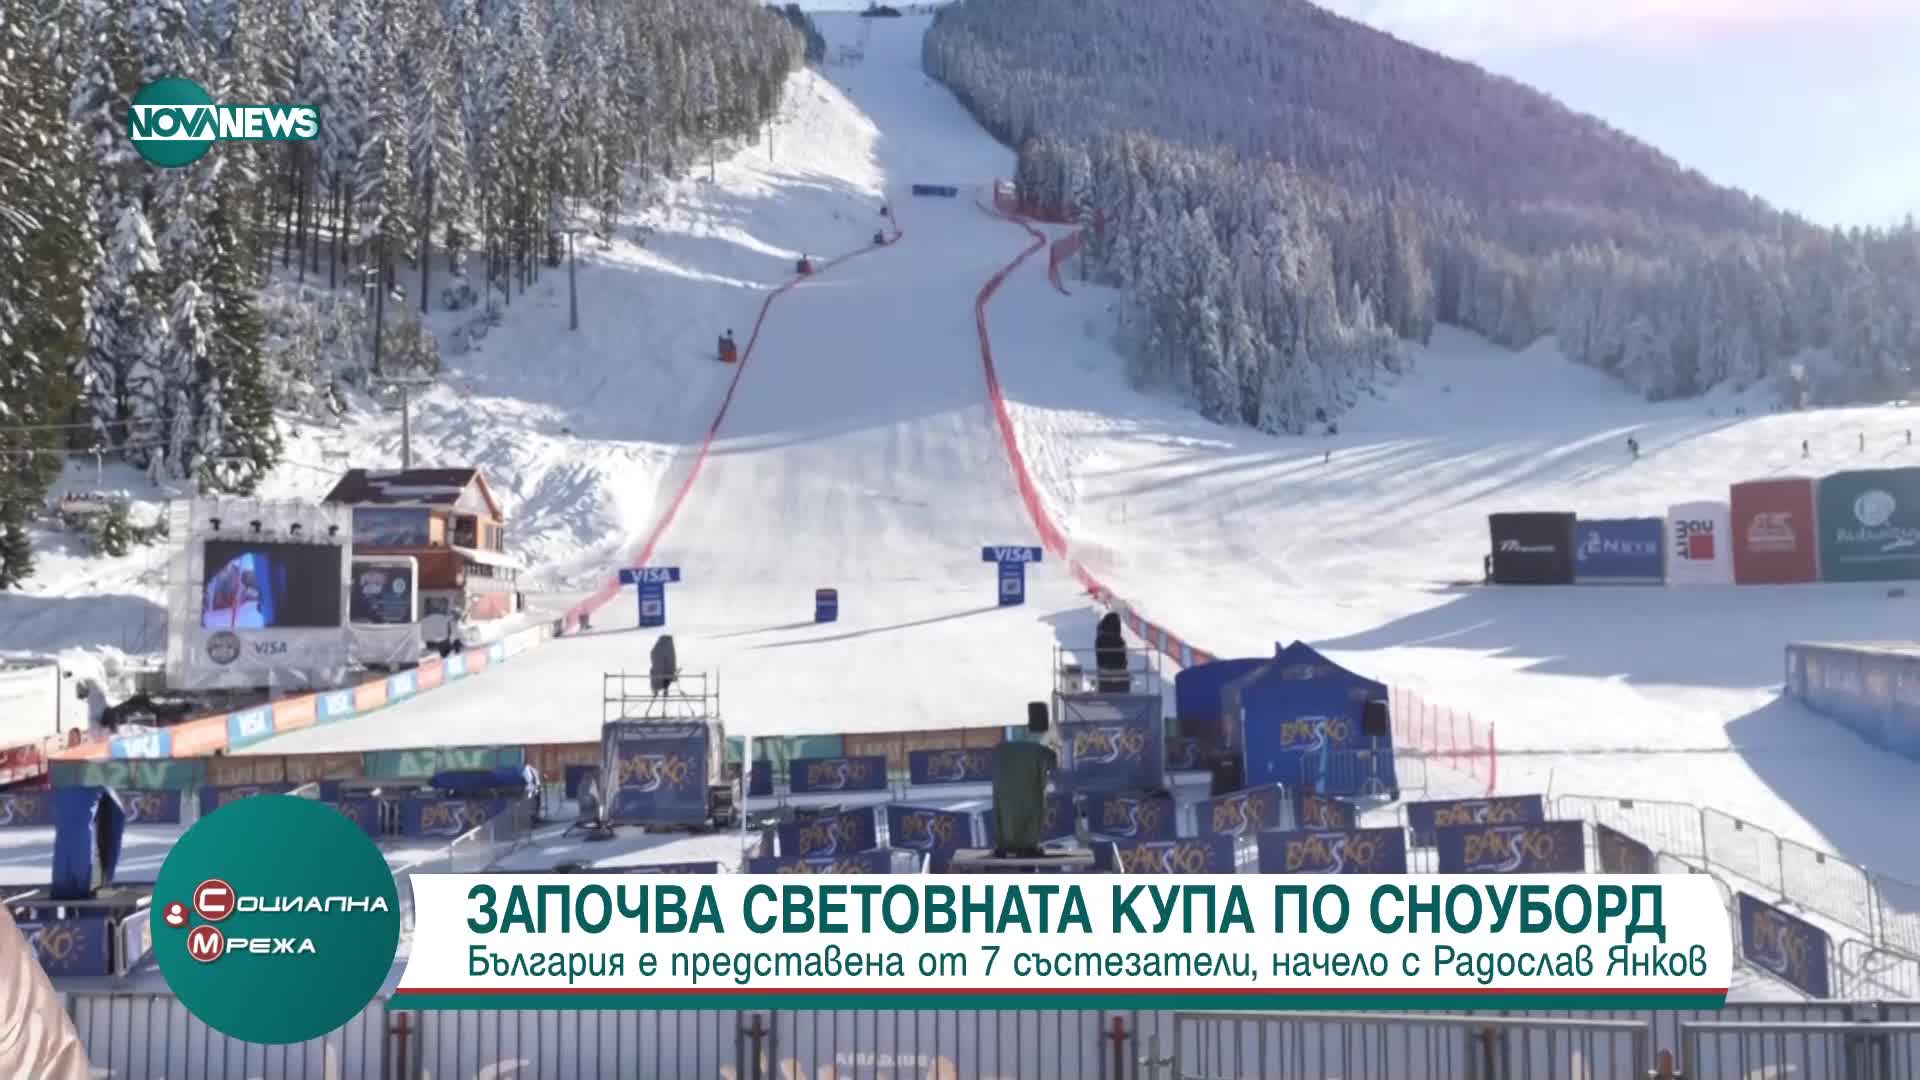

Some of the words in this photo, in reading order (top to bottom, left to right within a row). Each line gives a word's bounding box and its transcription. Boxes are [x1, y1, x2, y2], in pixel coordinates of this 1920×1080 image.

[993, 547, 1033, 561] VISA
[631, 570, 671, 583] VISA
[255, 641, 288, 654] VISA
[1286, 833, 1380, 874] BANSKO
[1463, 826, 1556, 871] BANSKO
